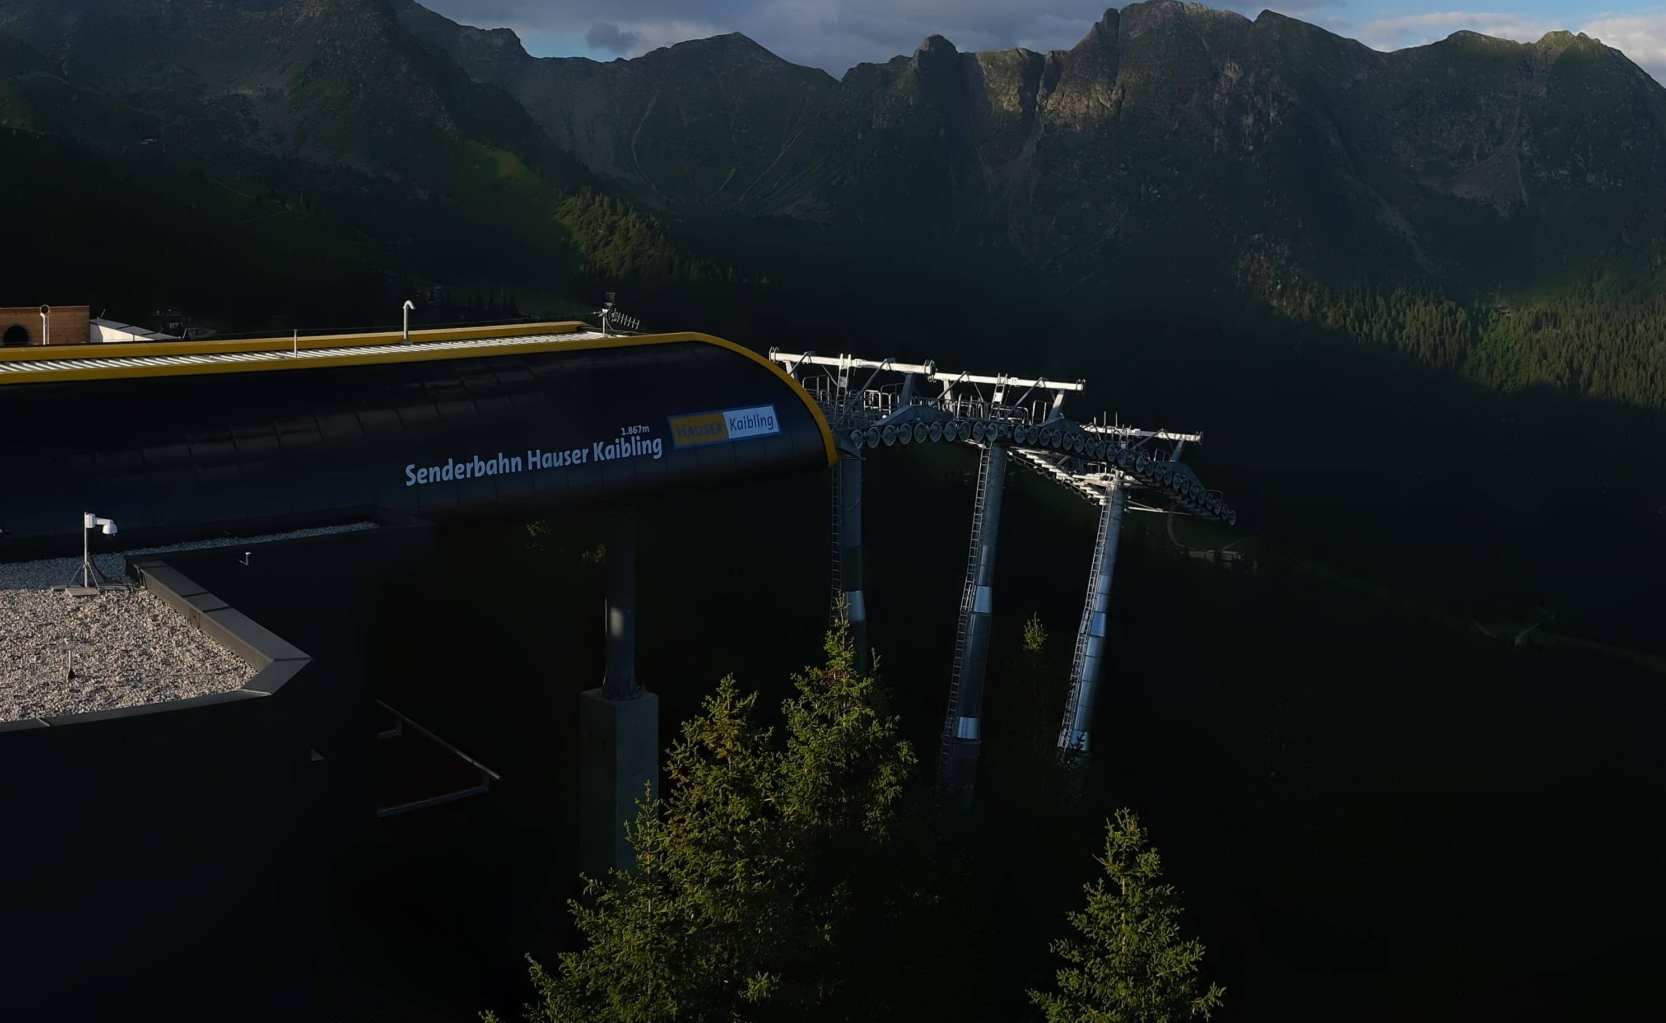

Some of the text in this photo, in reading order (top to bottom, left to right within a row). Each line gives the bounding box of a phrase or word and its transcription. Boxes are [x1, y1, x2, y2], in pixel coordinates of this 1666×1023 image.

[620, 424, 650, 436] 1.867m
[676, 414, 774, 438] HAUSER Kaibling
[405, 435, 663, 487] Senderbahn Hauser Kaibling
